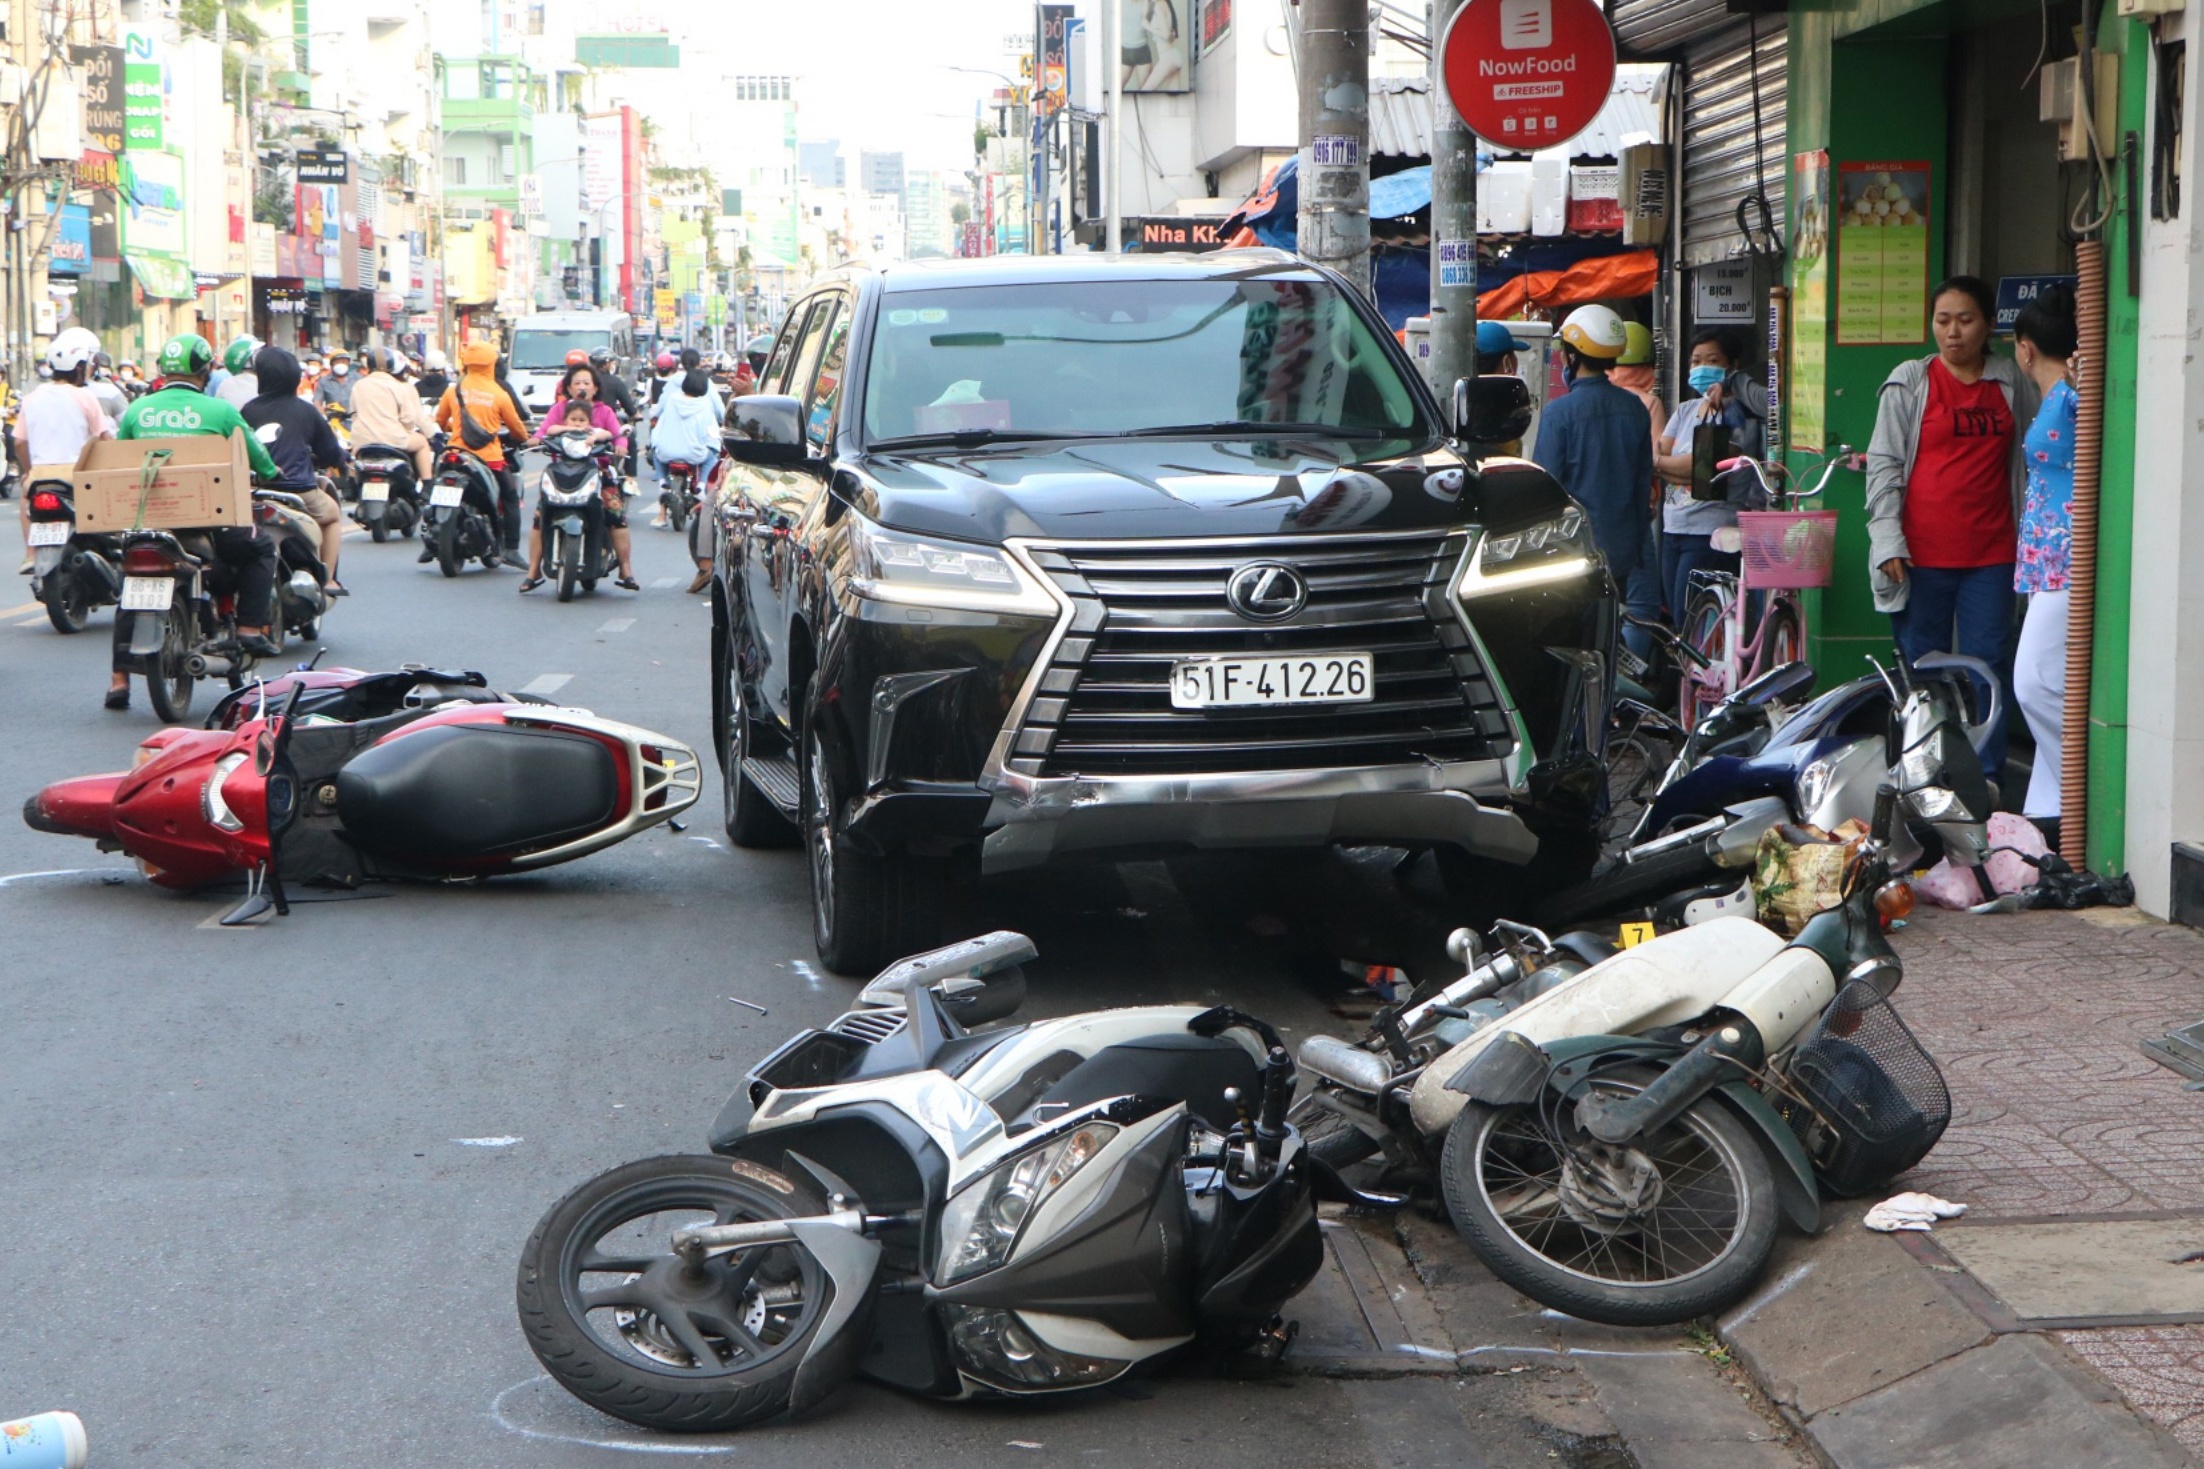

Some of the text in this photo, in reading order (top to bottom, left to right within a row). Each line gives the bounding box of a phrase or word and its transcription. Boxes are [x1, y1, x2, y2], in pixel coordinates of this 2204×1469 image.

[1479, 53, 1576, 76] NowFood
[87, 79, 109, 103] SỐ
[1508, 84, 1561, 96] FREESHIP
[87, 105, 123, 128] RÚNG
[1144, 224, 1187, 243] Nha
[1709, 285, 1732, 298] BỊCH
[2018, 281, 2038, 299] ĐÃ
[138, 404, 202, 429] Grab
[129, 594, 164, 608] 1102
[1181, 658, 1367, 702] 51F-412.26
[1632, 928, 1643, 944] 7
